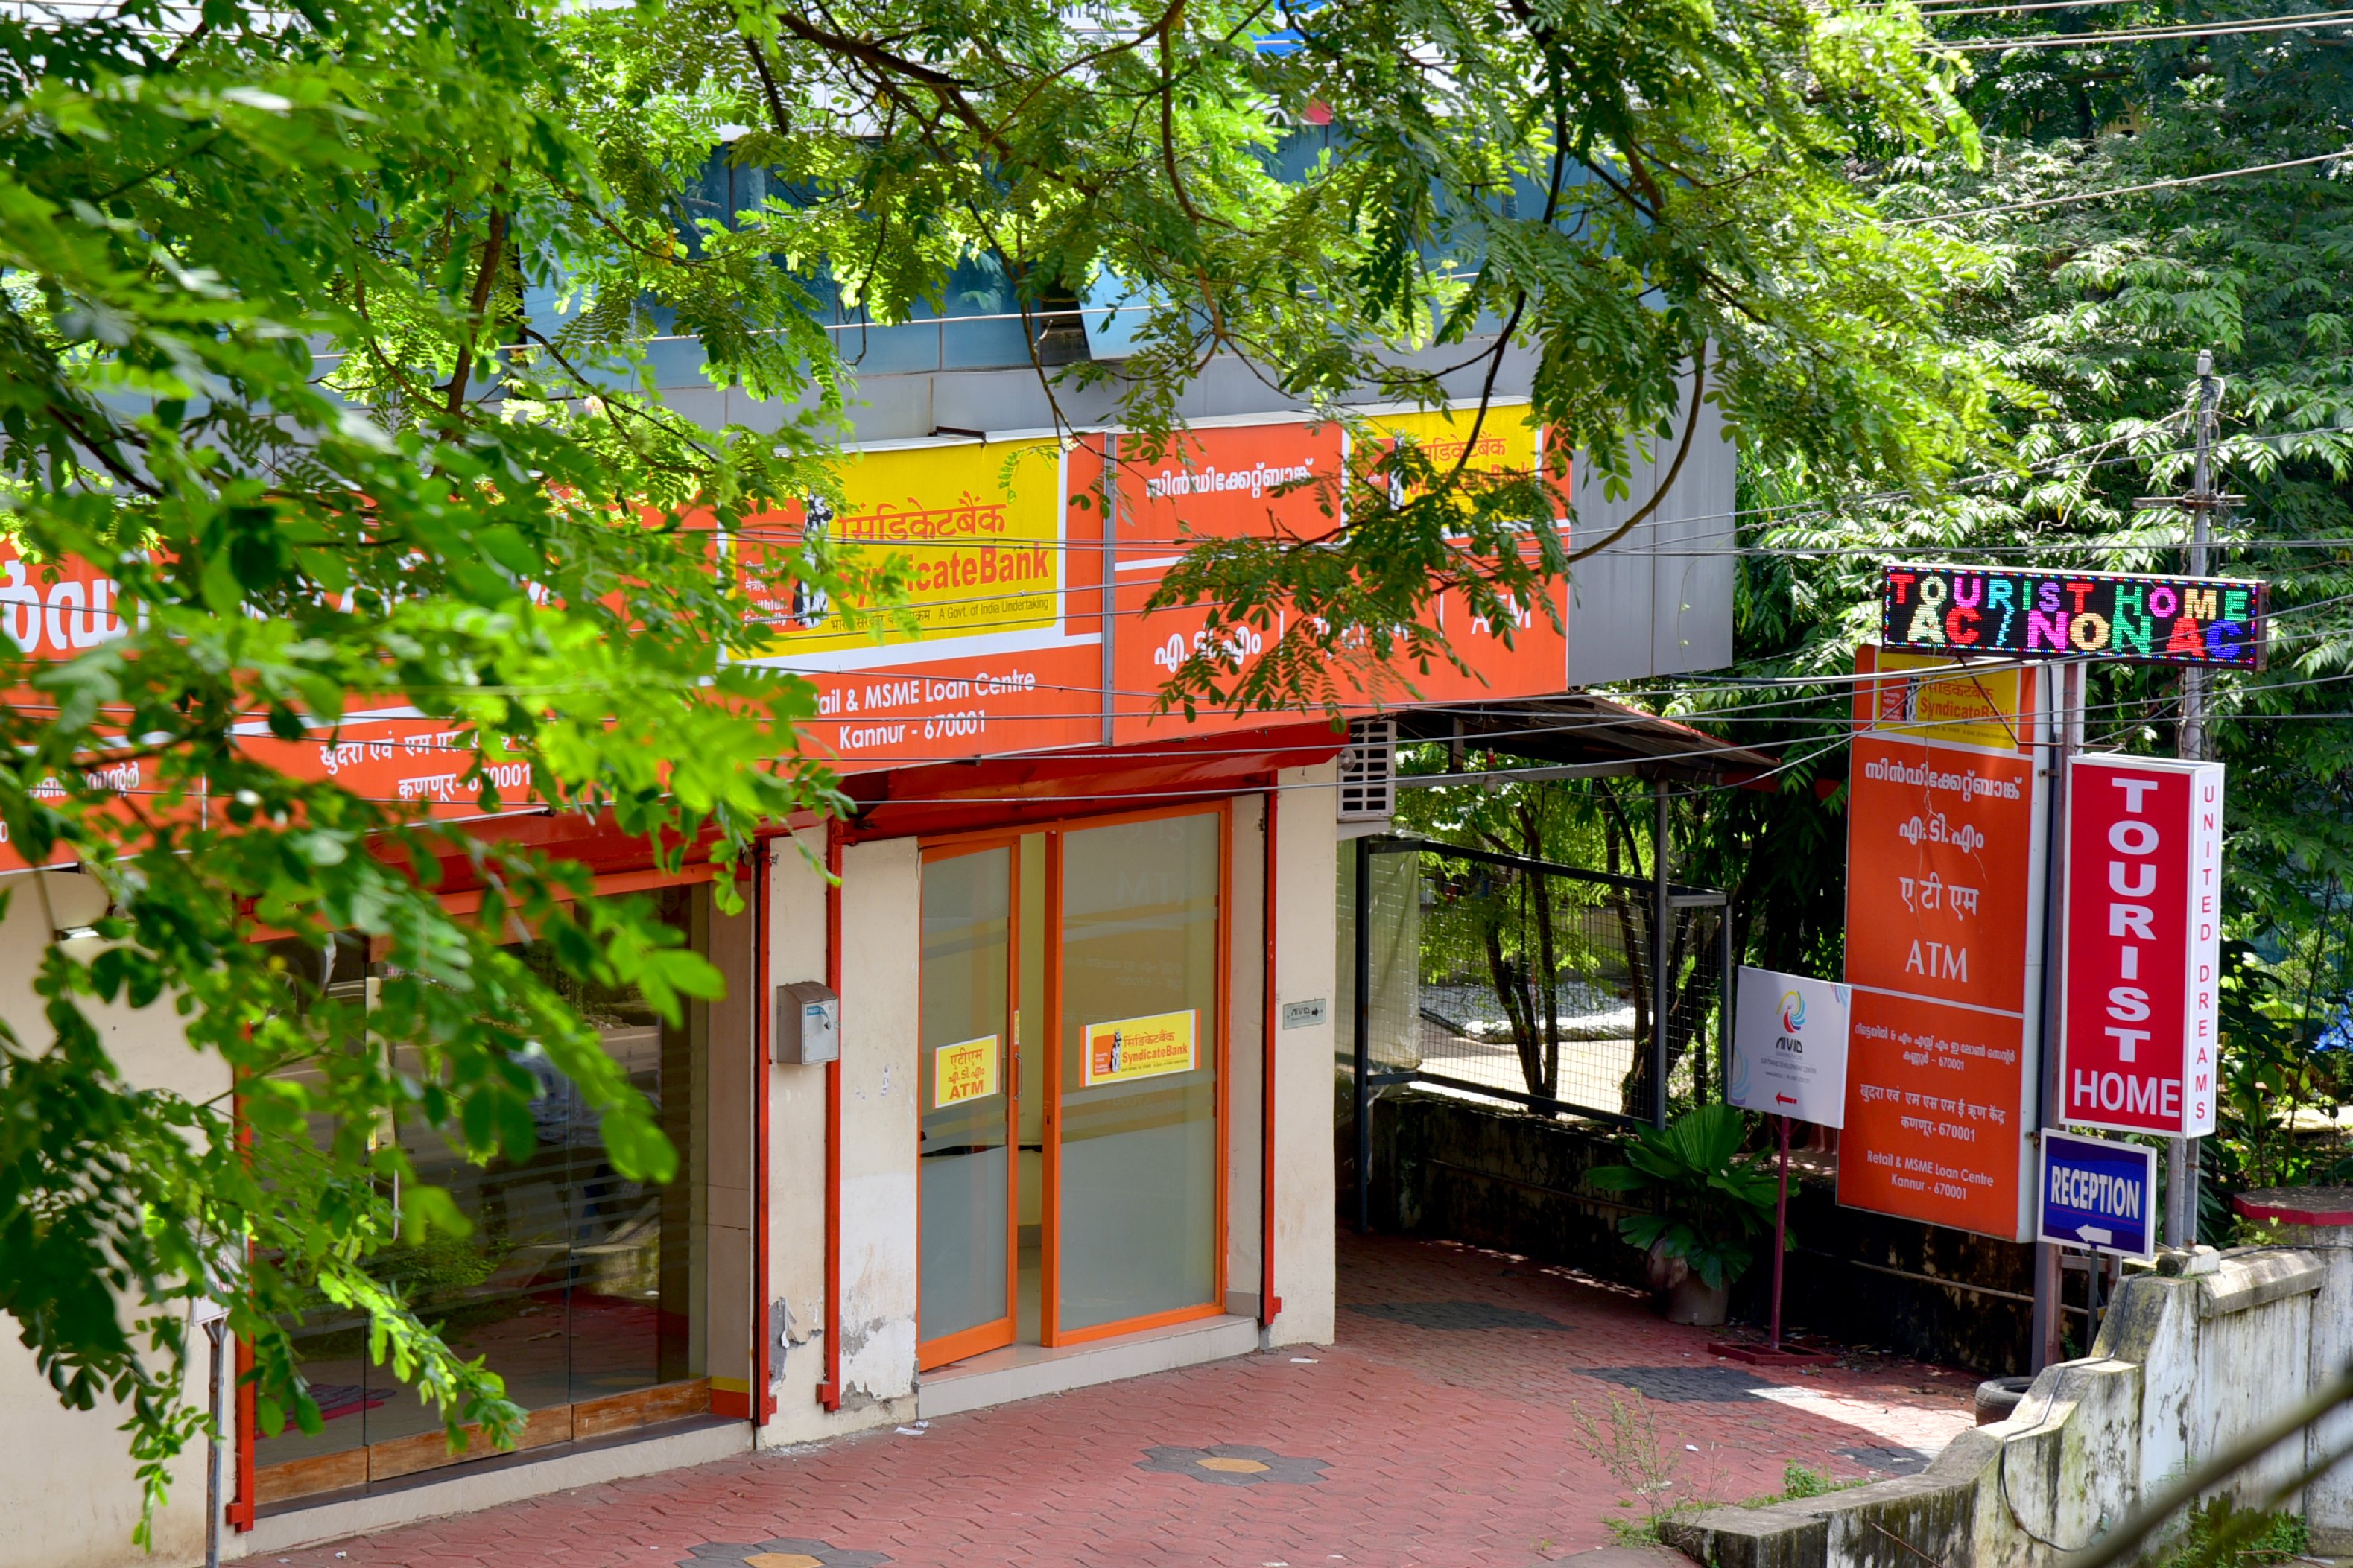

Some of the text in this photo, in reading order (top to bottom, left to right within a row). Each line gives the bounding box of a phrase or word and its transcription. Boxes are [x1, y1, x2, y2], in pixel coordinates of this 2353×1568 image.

[836, 542, 1050, 607] icateBank
[938, 597, 1049, 620] A Govt. of India Undertaking
[1471, 592, 1531, 634] AM
[1889, 574, 2248, 621] TOURIST HOME
[1907, 604, 1983, 644] AC
[2027, 609, 2154, 654] NON
[2166, 618, 2246, 658] AC
[846, 688, 859, 712] &
[864, 680, 919, 709] MSME
[925, 677, 969, 702] Loan
[975, 669, 1036, 696] Centre
[405, 734, 432, 756] एम
[840, 724, 906, 749] Kannur
[924, 710, 986, 740] 670001
[467, 762, 531, 792] 60001
[2104, 777, 2159, 1063] TOURIST
[1905, 939, 1968, 983] ATM
[2195, 785, 2215, 1120] UNITED DREAMS
[1122, 1043, 1188, 1065] SyndicateBank
[1939, 1056, 1965, 1070] 670001
[949, 1080, 984, 1099] ATM
[2073, 1069, 2182, 1117] HOME
[1939, 1123, 1975, 1142] 670001
[1867, 1150, 1994, 1187] Retail & MSME Loan Centre
[1891, 1174, 1925, 1191] Kannur
[1934, 1181, 1966, 1201] 670001
[2050, 1165, 2141, 1220] RECEPTION
